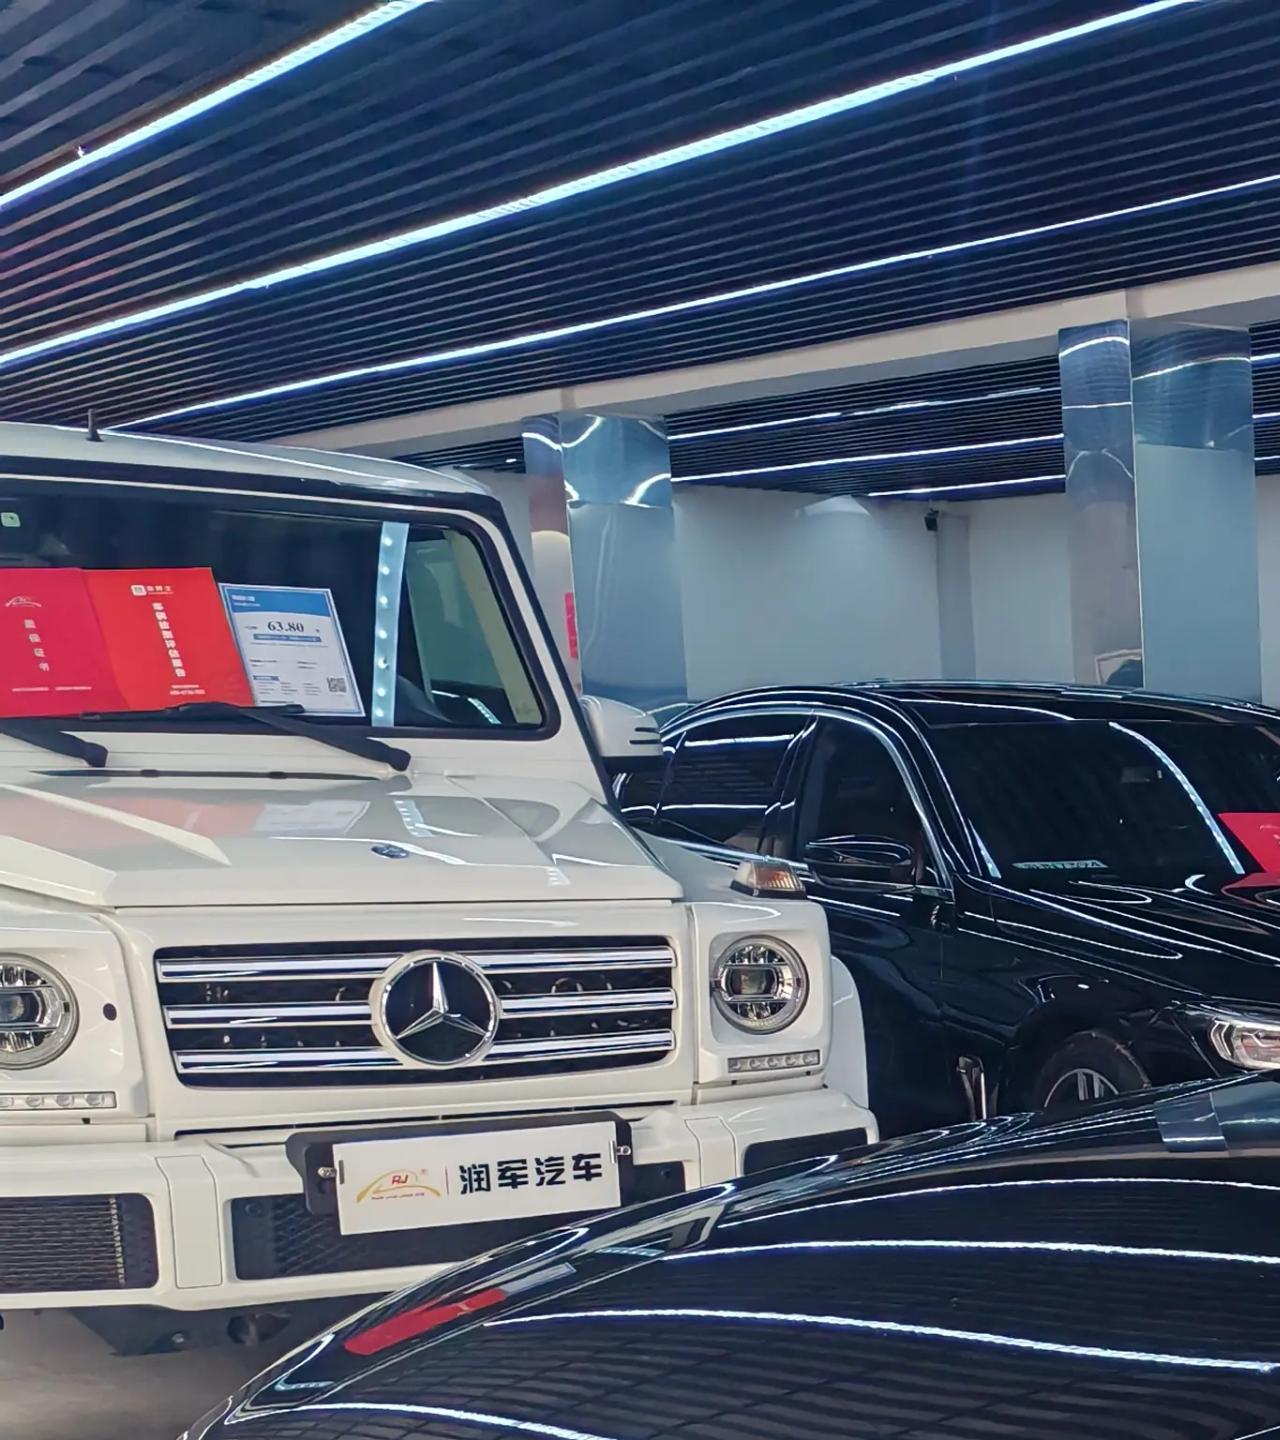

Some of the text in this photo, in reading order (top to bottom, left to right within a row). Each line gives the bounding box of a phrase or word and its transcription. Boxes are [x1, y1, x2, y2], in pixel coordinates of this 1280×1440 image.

[267, 620, 304, 633] 63.80
[391, 1173, 409, 1186] RJ
[458, 1152, 604, 1196] 润军汽车
